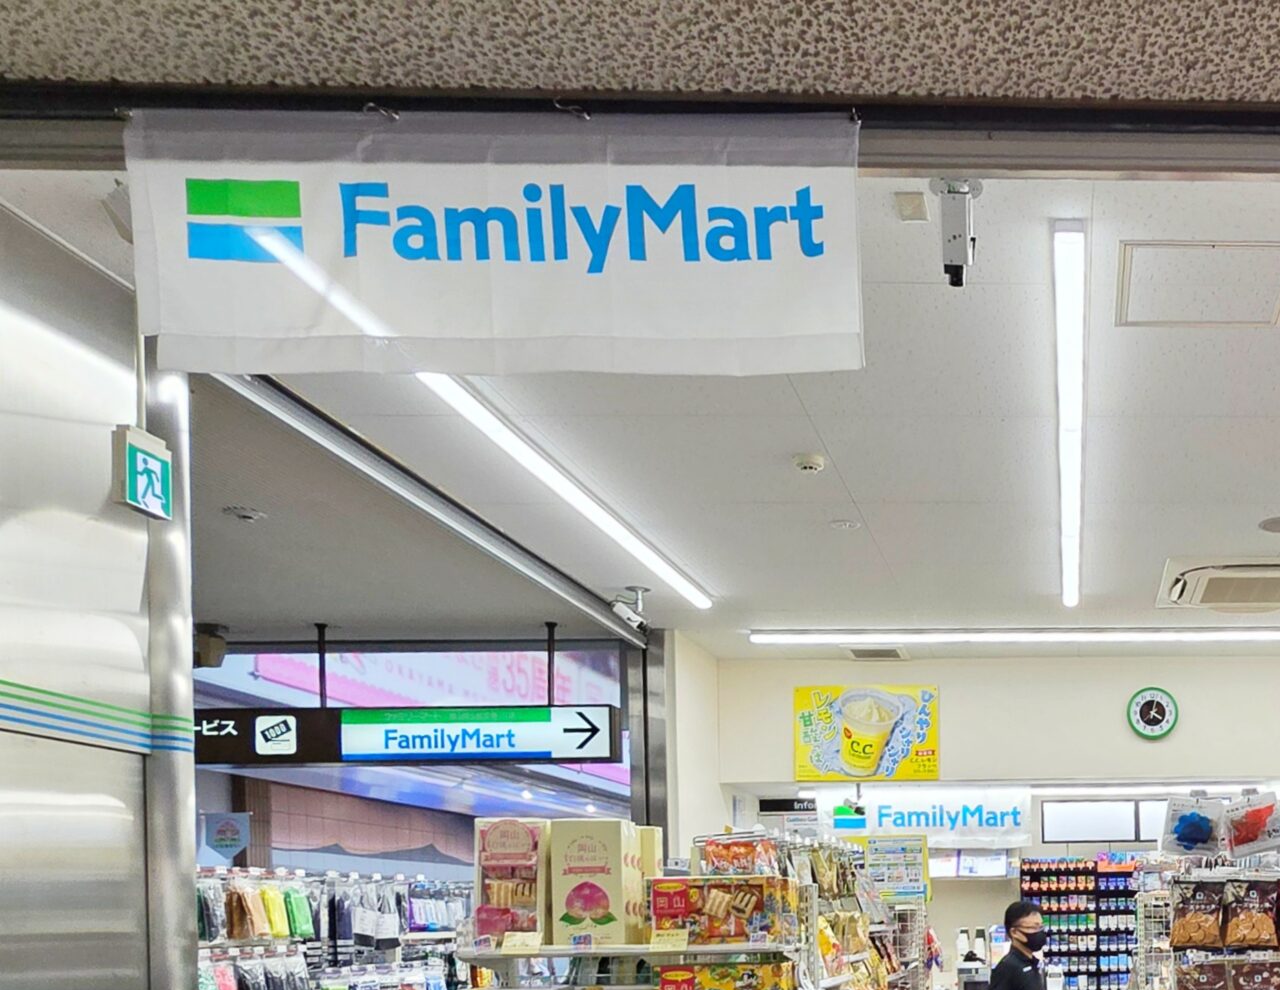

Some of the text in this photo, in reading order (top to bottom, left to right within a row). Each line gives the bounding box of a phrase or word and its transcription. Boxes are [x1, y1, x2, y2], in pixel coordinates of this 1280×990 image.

[338, 182, 825, 274] FamilyMart
[916, 689, 935, 744] ひんやり
[384, 728, 516, 752] FamilyMart
[877, 804, 1021, 831] FamilyMart
[656, 896, 686, 908] 岡山
